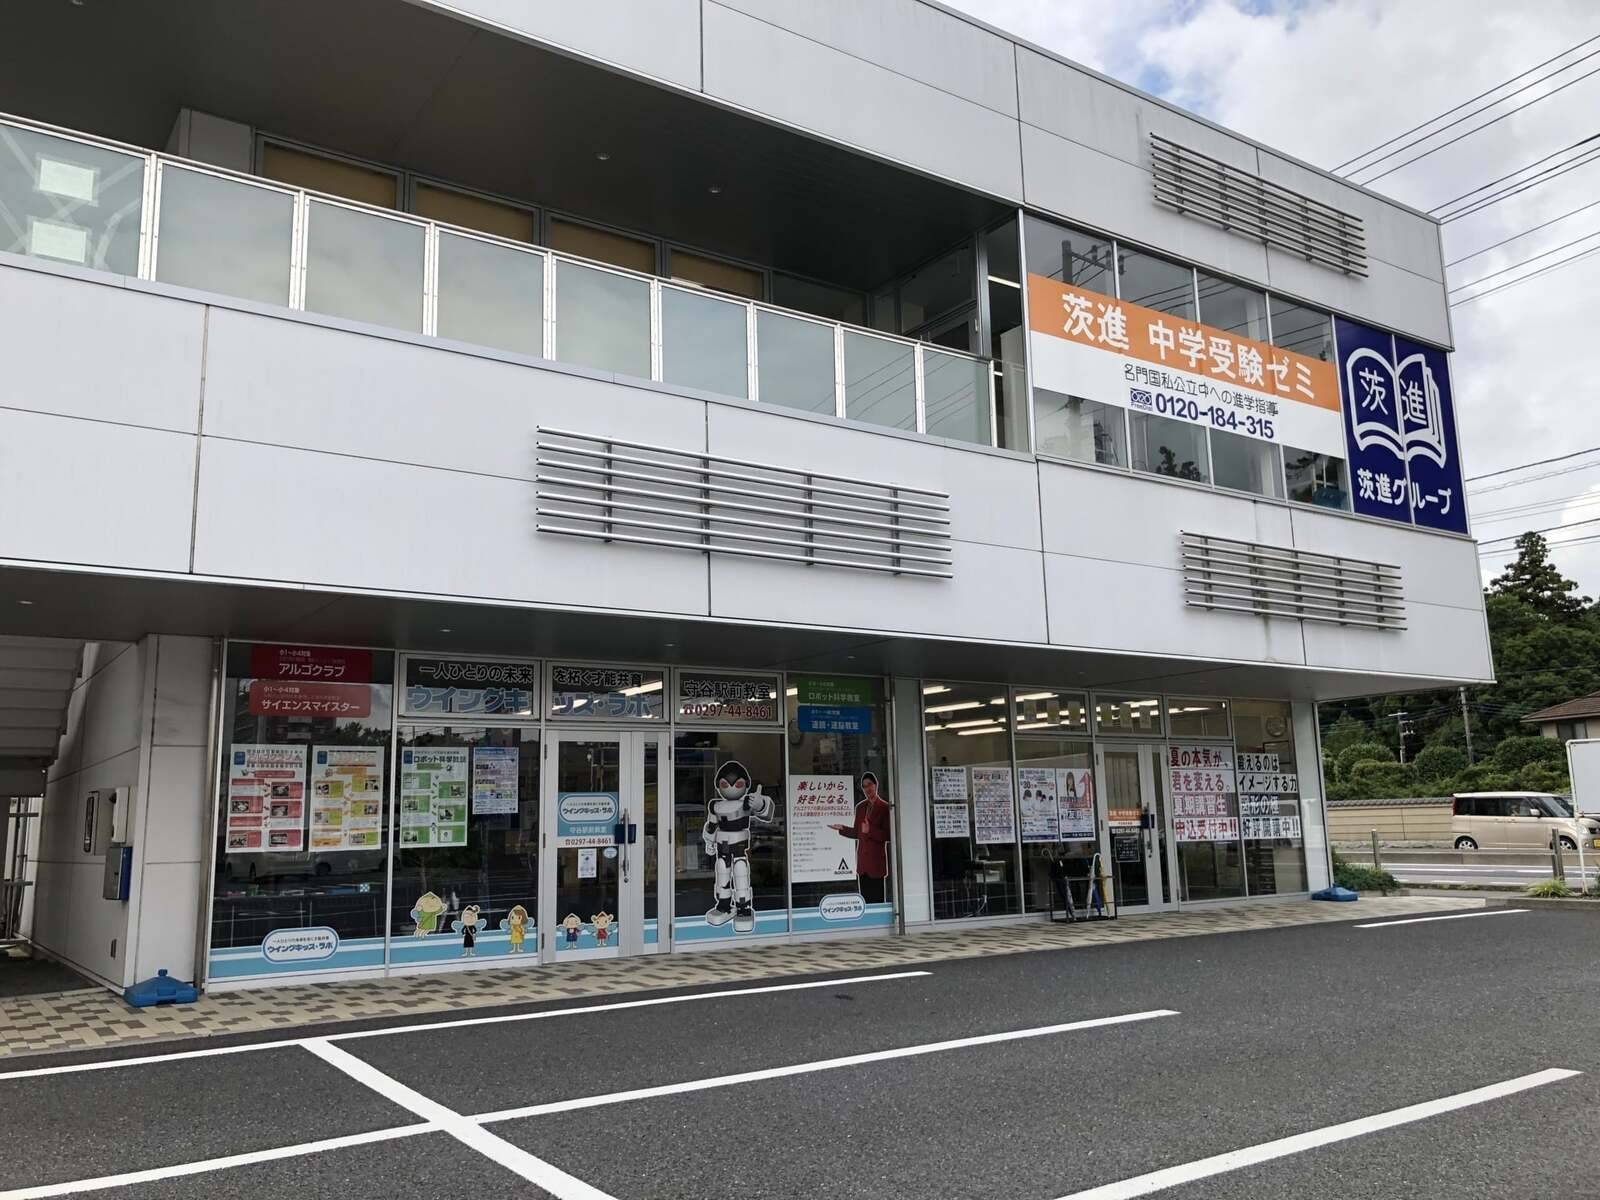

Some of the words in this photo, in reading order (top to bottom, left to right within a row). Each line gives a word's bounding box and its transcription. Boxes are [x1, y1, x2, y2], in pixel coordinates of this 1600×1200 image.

[1061, 292, 1130, 351] 茨進
[1148, 318, 1315, 400] 中学受験ゼミ
[1124, 363, 1279, 417] 名門国私公立中への進学指導
[1155, 392, 1275, 439] 0120-184-315
[1356, 467, 1452, 515] 茨進グループ
[278, 662, 346, 677] アルゴクラブ
[419, 662, 534, 684] 一人ひとりの未来
[683, 679, 771, 700] 守谷駅前教室
[262, 700, 360, 712] サイエンスマイスター
[694, 703, 771, 719] 0297-44-8461
[1169, 746, 1230, 768] 夏の本気が、
[796, 780, 848, 791] 楽しいから、
[1171, 770, 1231, 792] 君を変える。
[1239, 774, 1298, 793] イメージする力
[796, 794, 848, 805] 好きになる。
